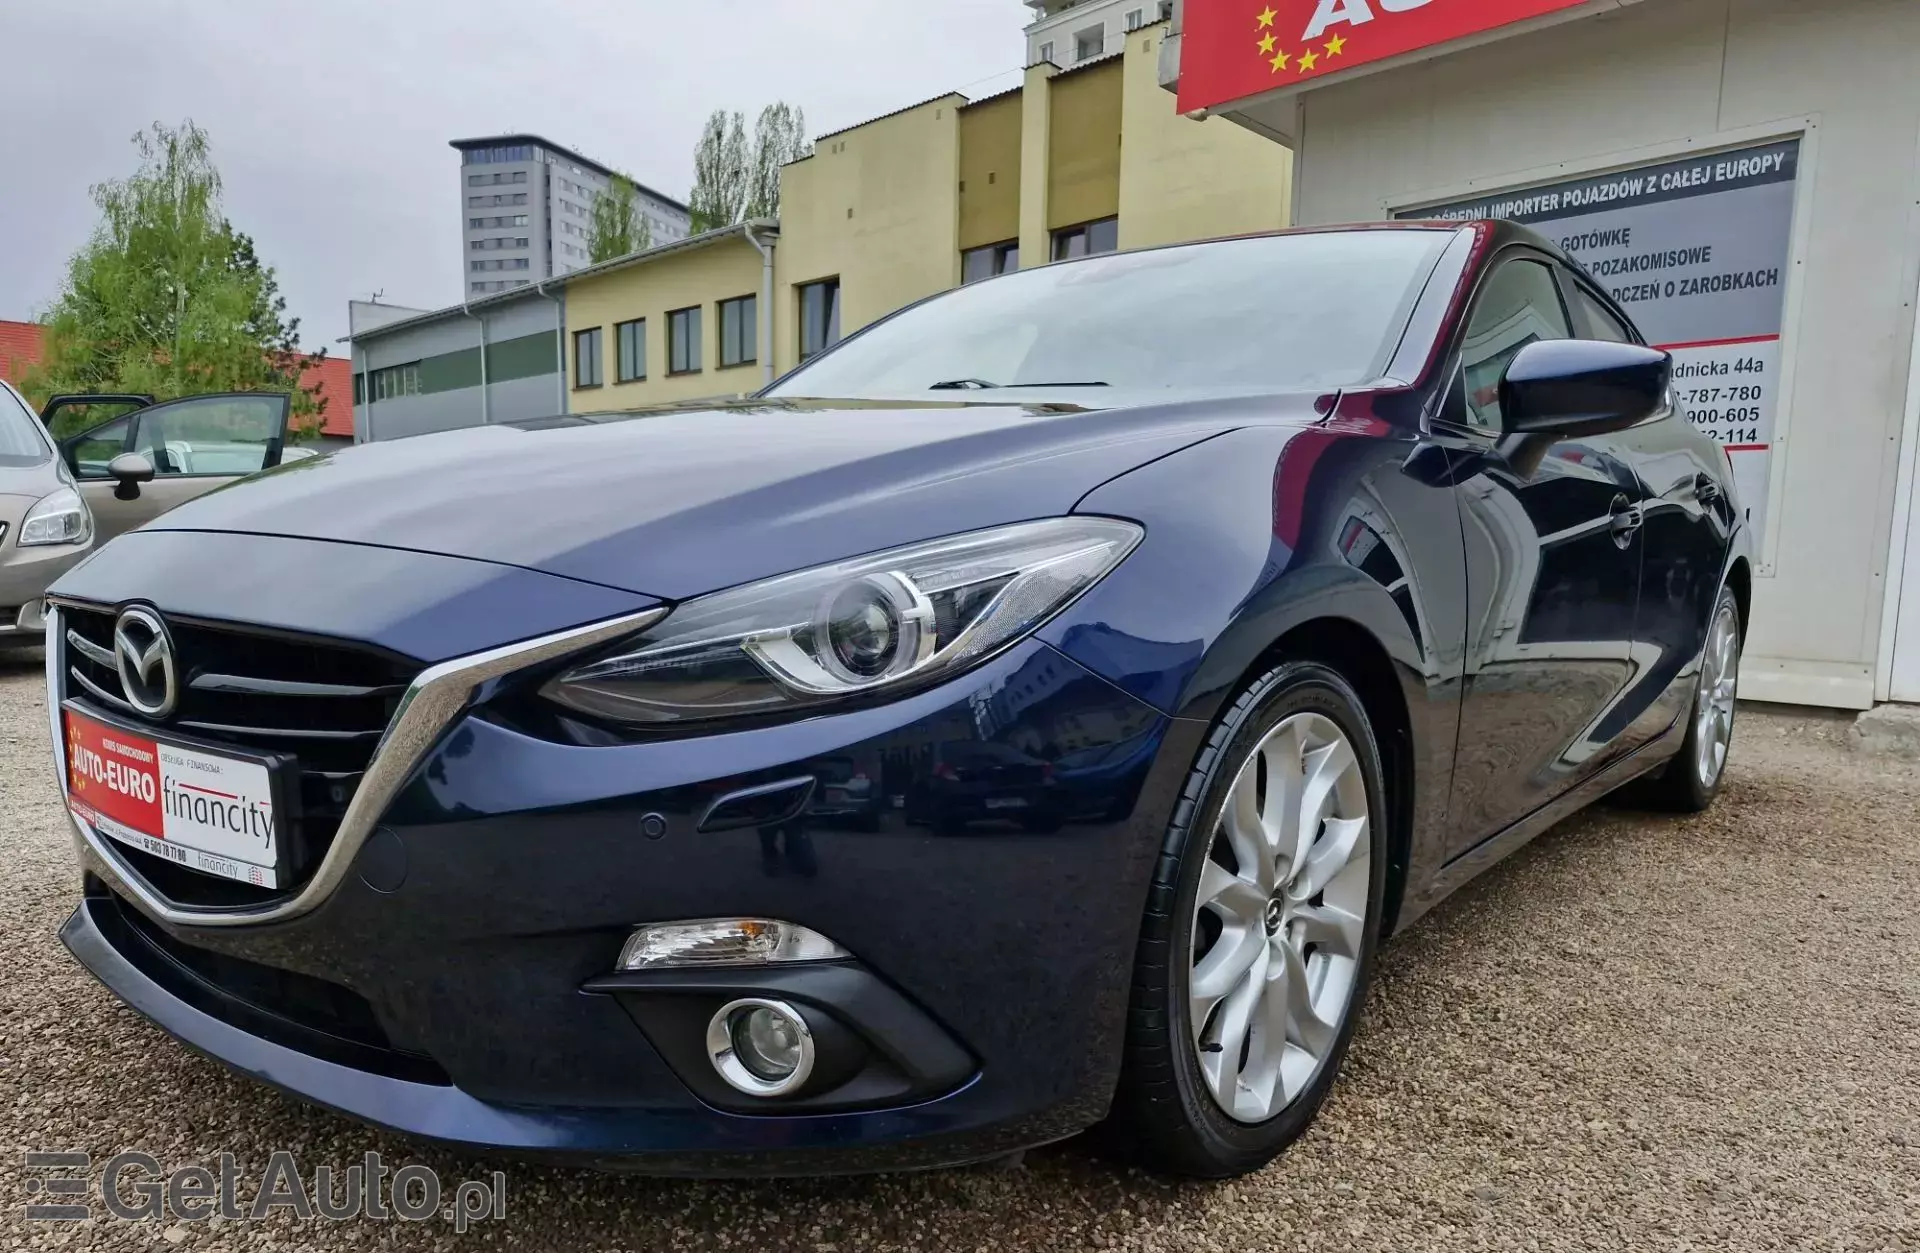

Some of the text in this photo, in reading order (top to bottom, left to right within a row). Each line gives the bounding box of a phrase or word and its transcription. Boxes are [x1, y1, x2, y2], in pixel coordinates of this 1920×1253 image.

[1490, 196, 1559, 219] IMPORTER
[1563, 178, 1643, 208] POJAZDÓW
[1646, 175, 1657, 194] Z
[1660, 165, 1711, 191] CAŁEJ
[1715, 152, 1785, 182] EUROPY
[1561, 227, 1631, 251] GOTÓWKĘ
[1592, 246, 1711, 276] POZAKOMISOWE
[1612, 267, 1779, 303] DCZEŃ O ZAROBKACH
[1733, 356, 1764, 374] 44a
[1677, 385, 1762, 403] -787-780
[1701, 428, 1758, 443] 2-114
[74, 743, 156, 804] AUTO-EURO
[163, 775, 274, 849] financity
[197, 851, 239, 878] financity
